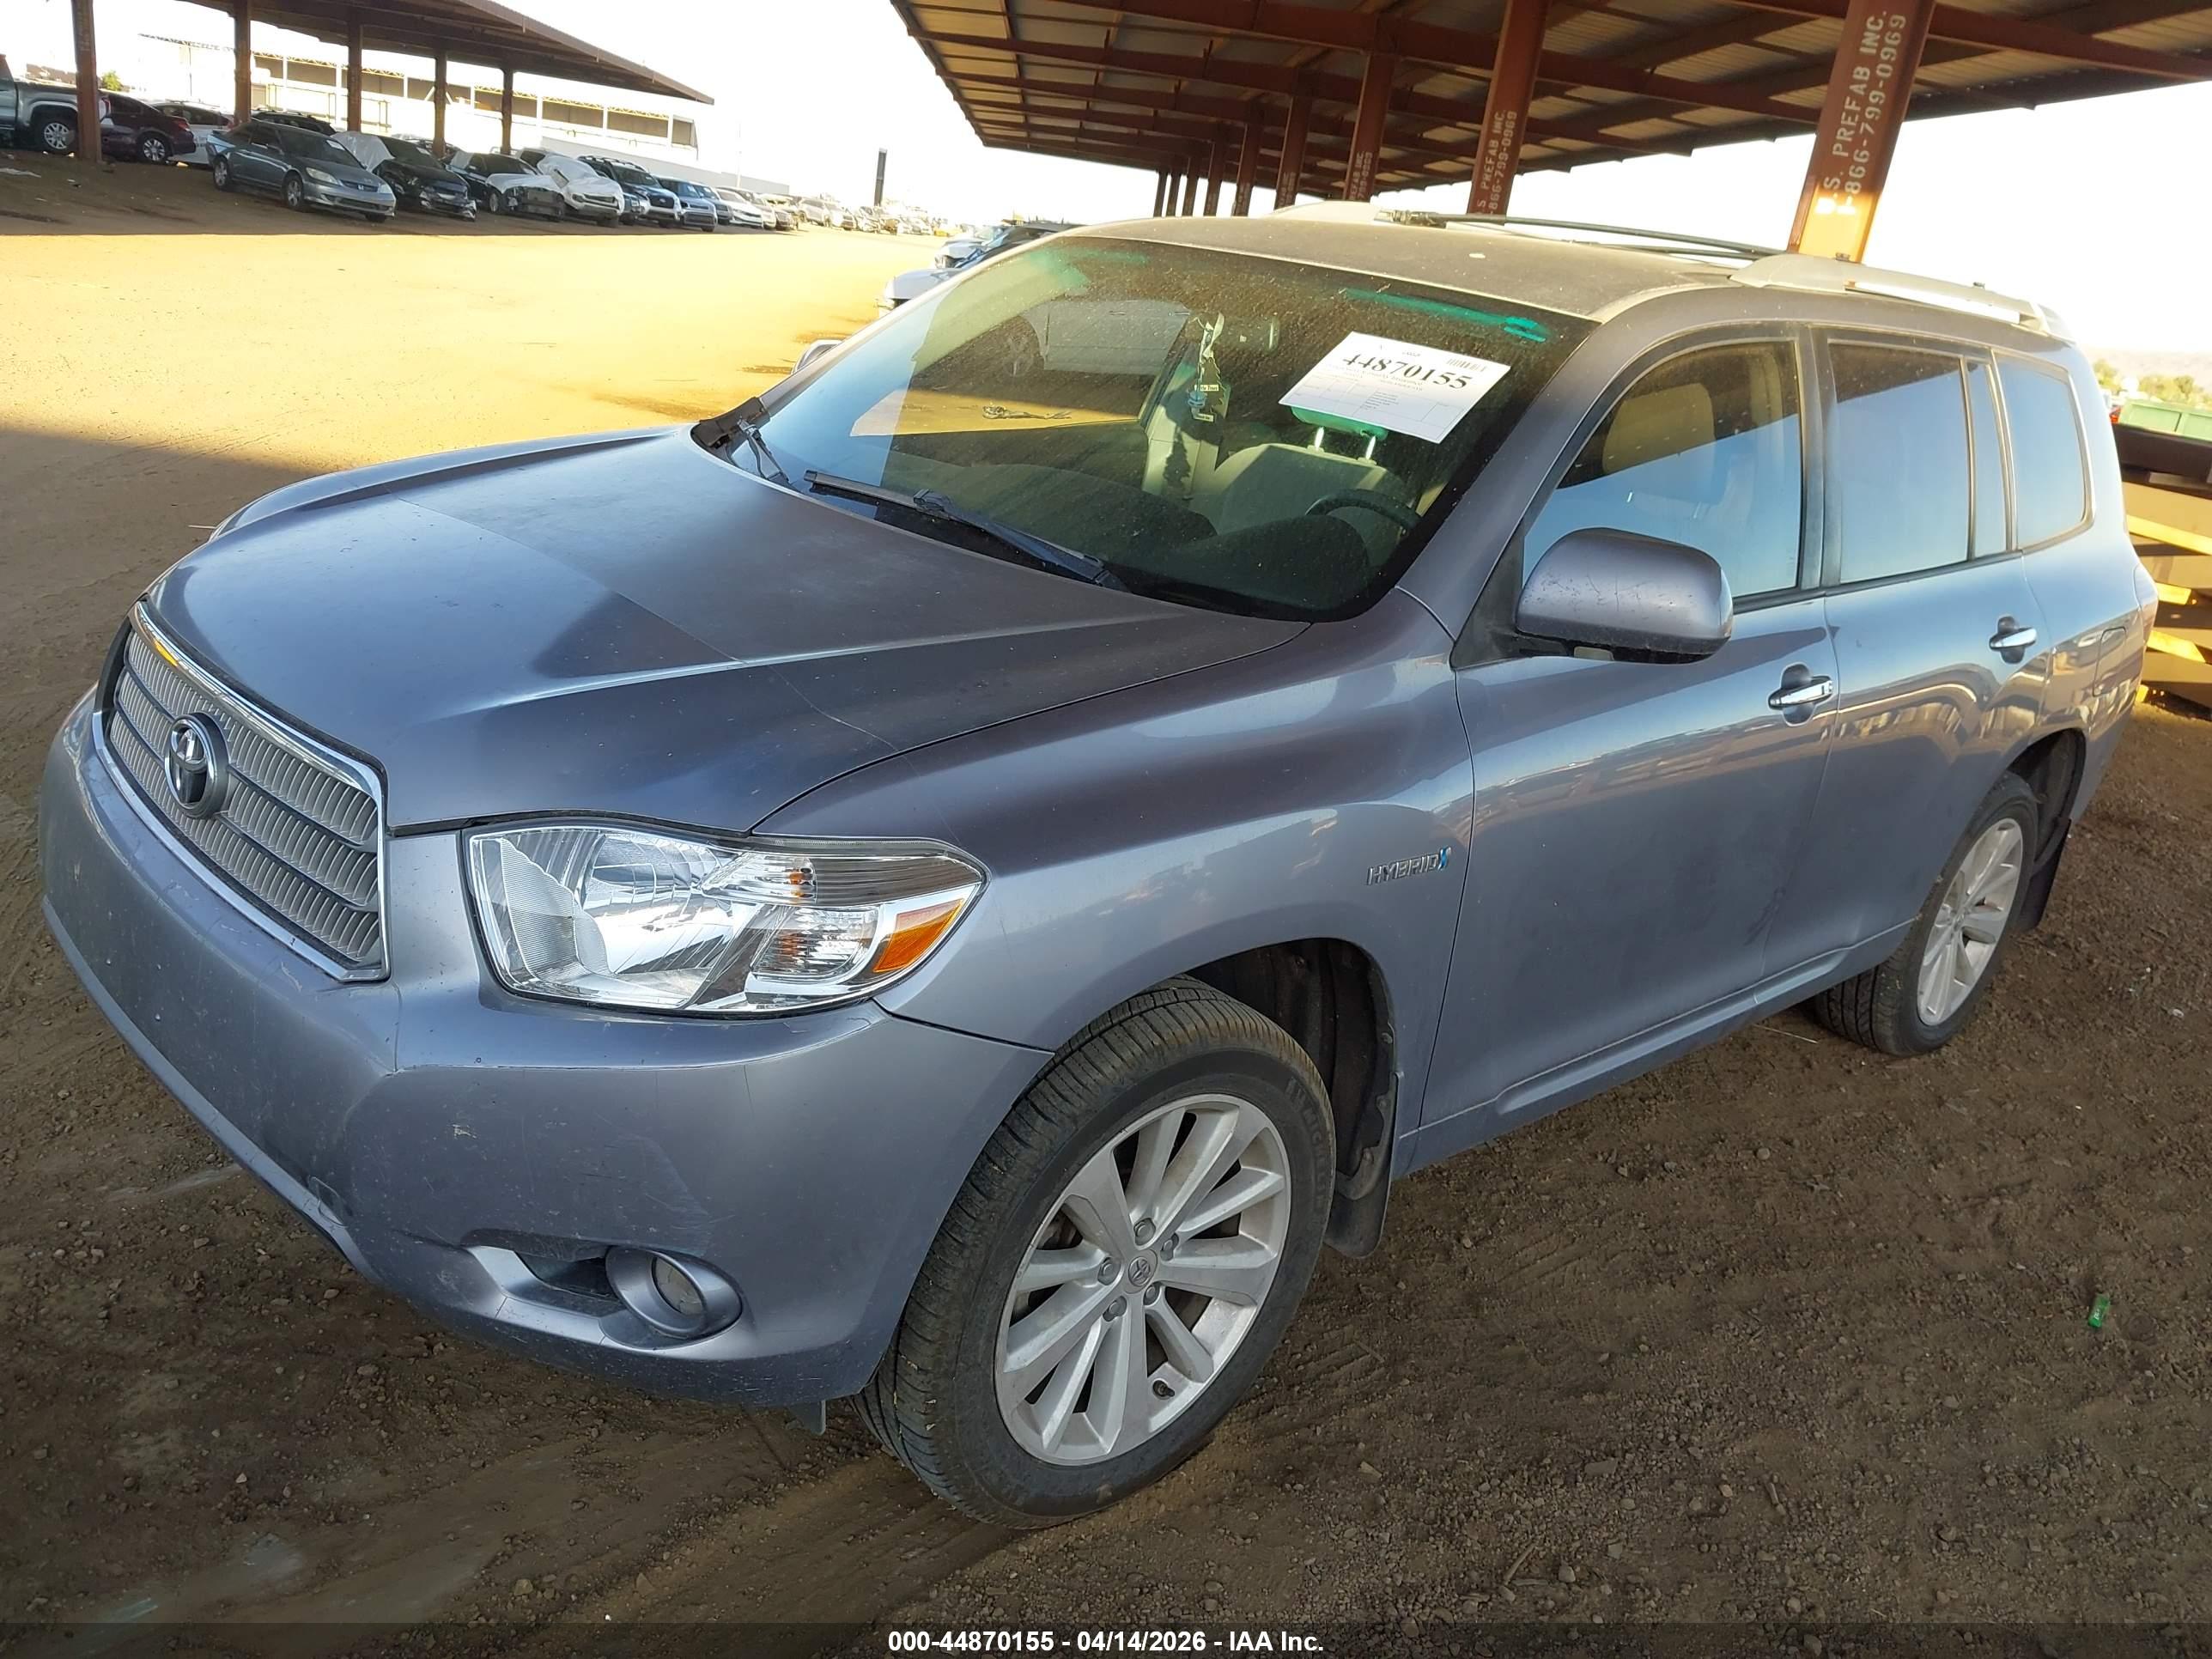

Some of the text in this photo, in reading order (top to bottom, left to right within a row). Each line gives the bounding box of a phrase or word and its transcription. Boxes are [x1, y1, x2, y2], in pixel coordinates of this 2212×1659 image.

[1832, 64, 1871, 158] PREFAB
[1859, 10, 1887, 55] INC.
[1837, 13, 1906, 215] 1-866-799-0969
[1480, 138, 1499, 190] PREFAB
[1488, 110, 1518, 216] -866-799-0969
[1342, 353, 1474, 389] 44870155
[1366, 853, 1440, 886] HYBRID
